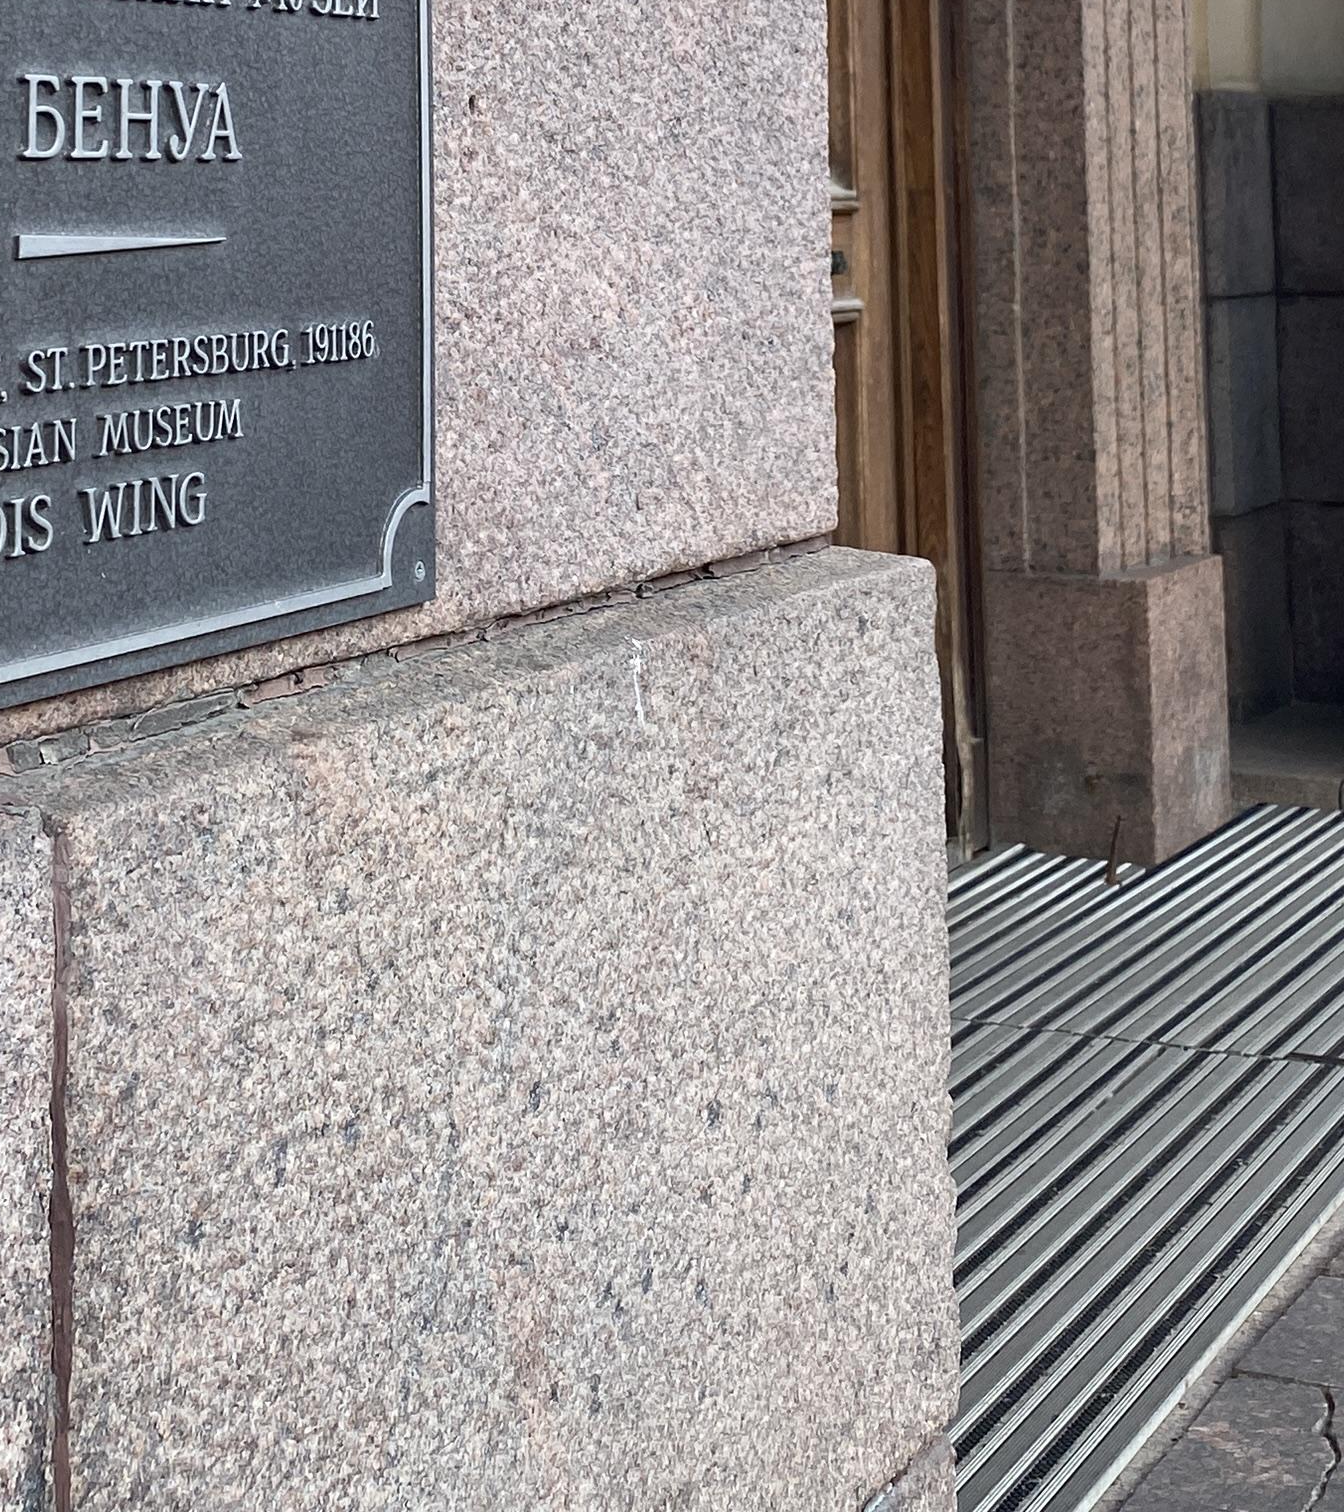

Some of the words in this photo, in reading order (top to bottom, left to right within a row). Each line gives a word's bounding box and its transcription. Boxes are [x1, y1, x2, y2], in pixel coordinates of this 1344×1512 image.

[21, 72, 243, 162] БЕНУА
[96, 398, 244, 458] MUSEUM
[83, 471, 207, 545] WING
